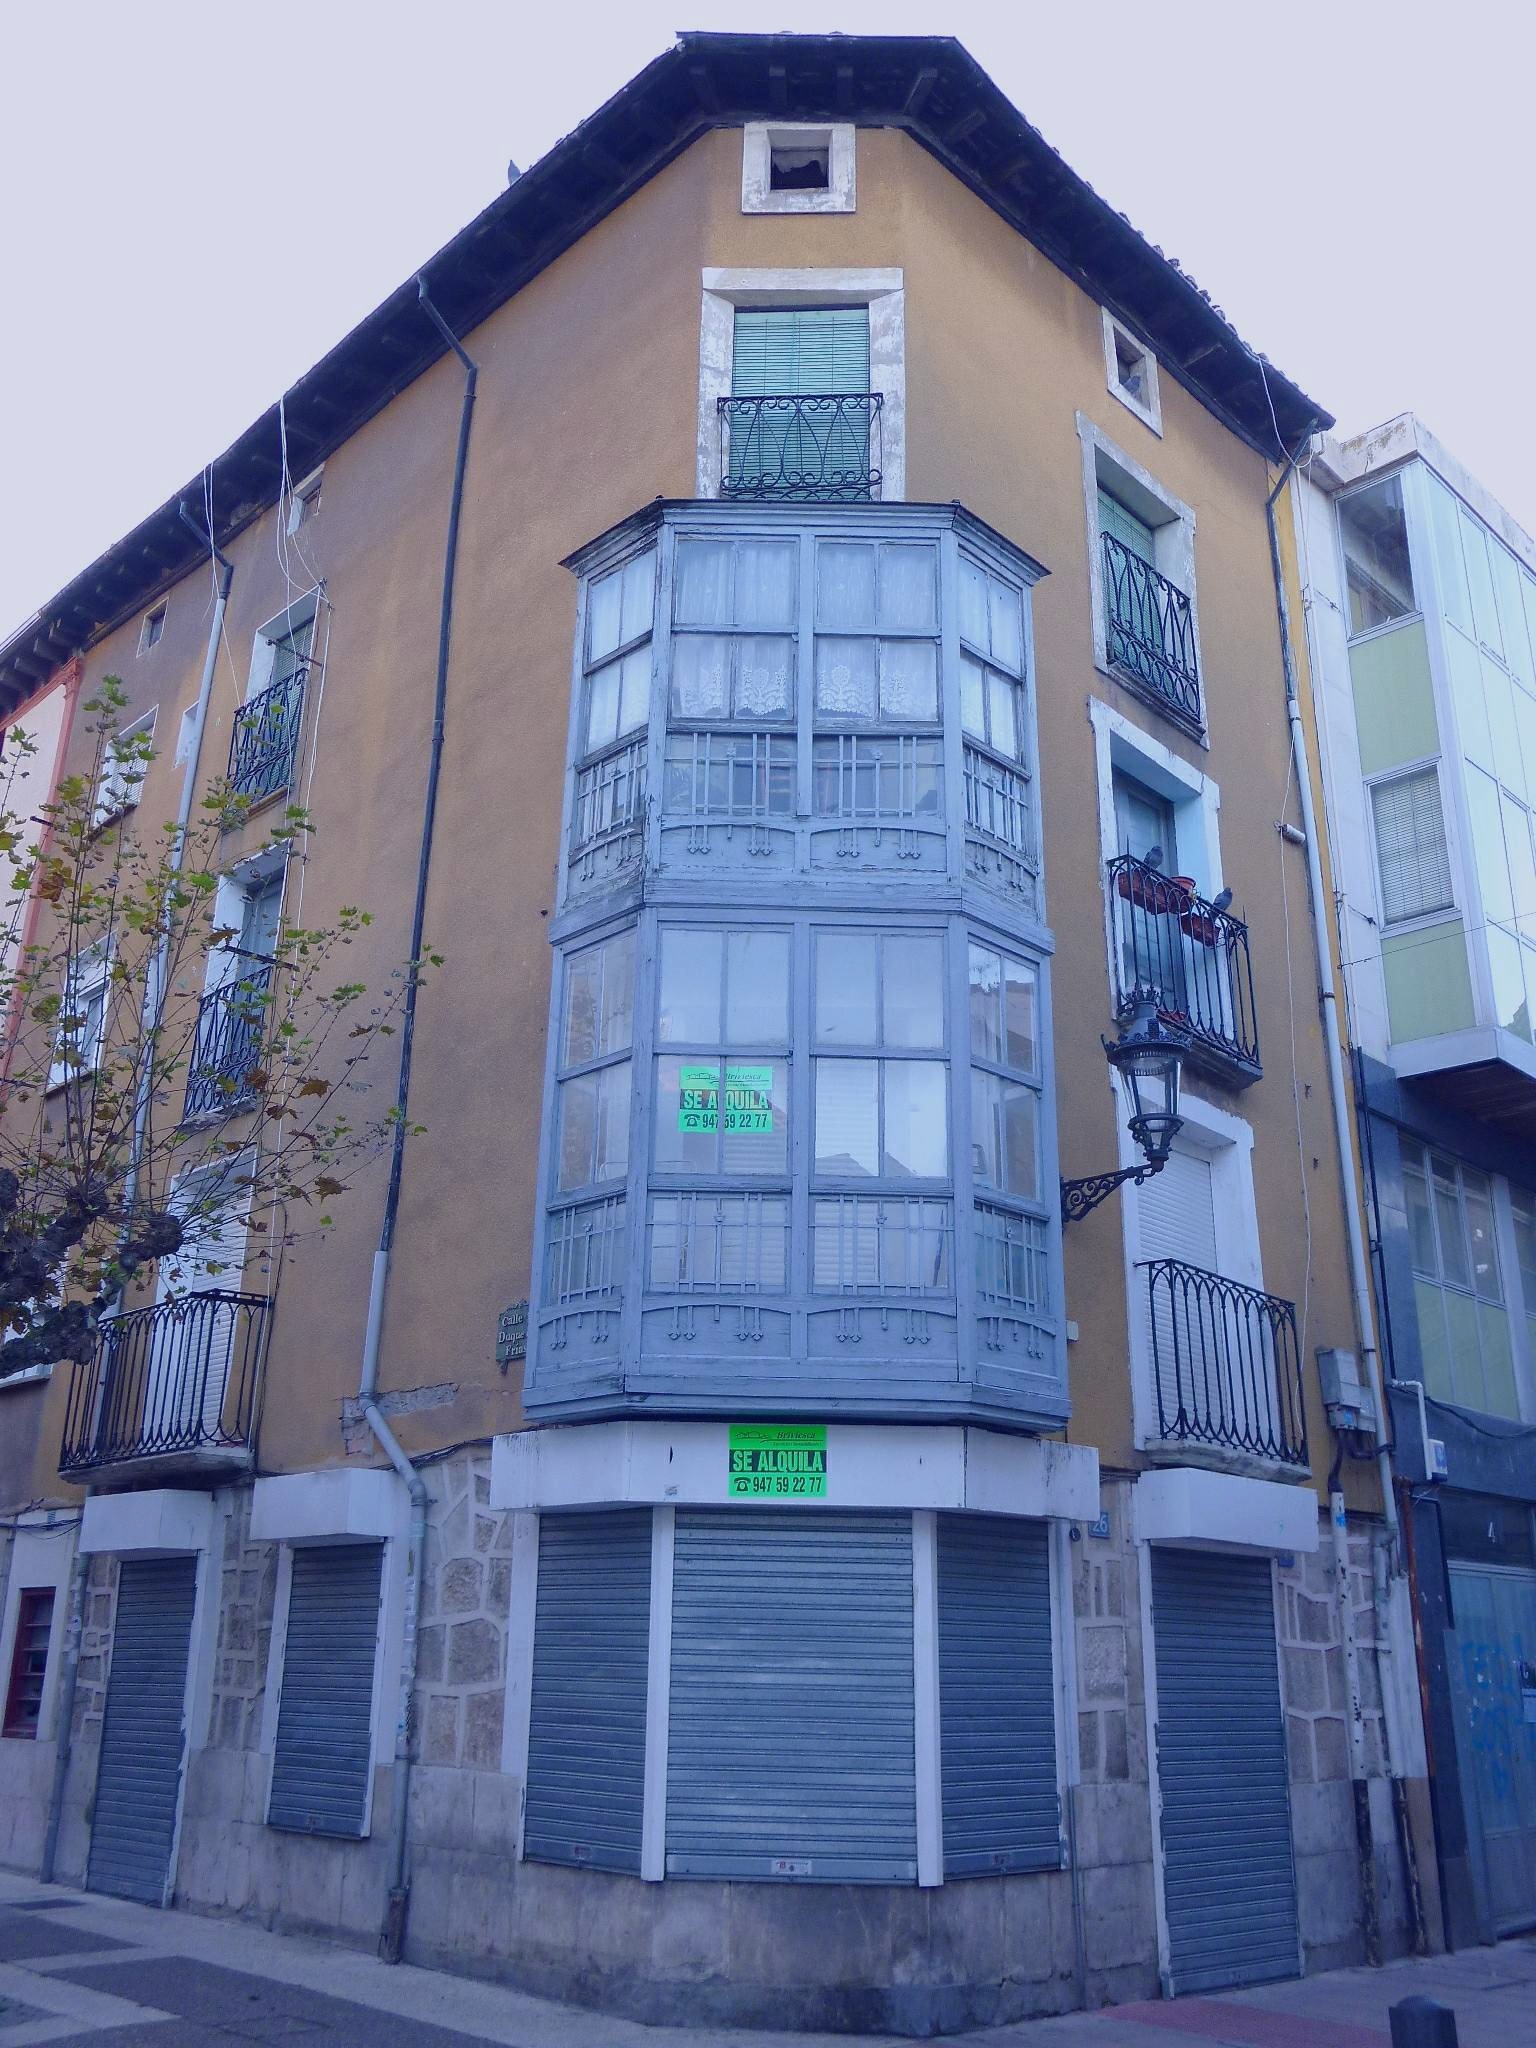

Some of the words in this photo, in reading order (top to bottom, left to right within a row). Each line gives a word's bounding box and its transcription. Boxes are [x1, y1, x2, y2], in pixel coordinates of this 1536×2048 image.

[684, 1090, 702, 1109] SE
[708, 1090, 769, 1110] AQUILA
[739, 1114, 751, 1128] 22
[755, 1114, 767, 1128] 77
[502, 1313, 523, 1327] Calle
[499, 1331, 525, 1343] Duque
[733, 1450, 752, 1472] SE
[757, 1450, 823, 1473] ALQUILA
[753, 1477, 772, 1492] 947
[776, 1477, 788, 1492] 59
[793, 1477, 805, 1492] 22
[809, 1477, 822, 1492] 77
